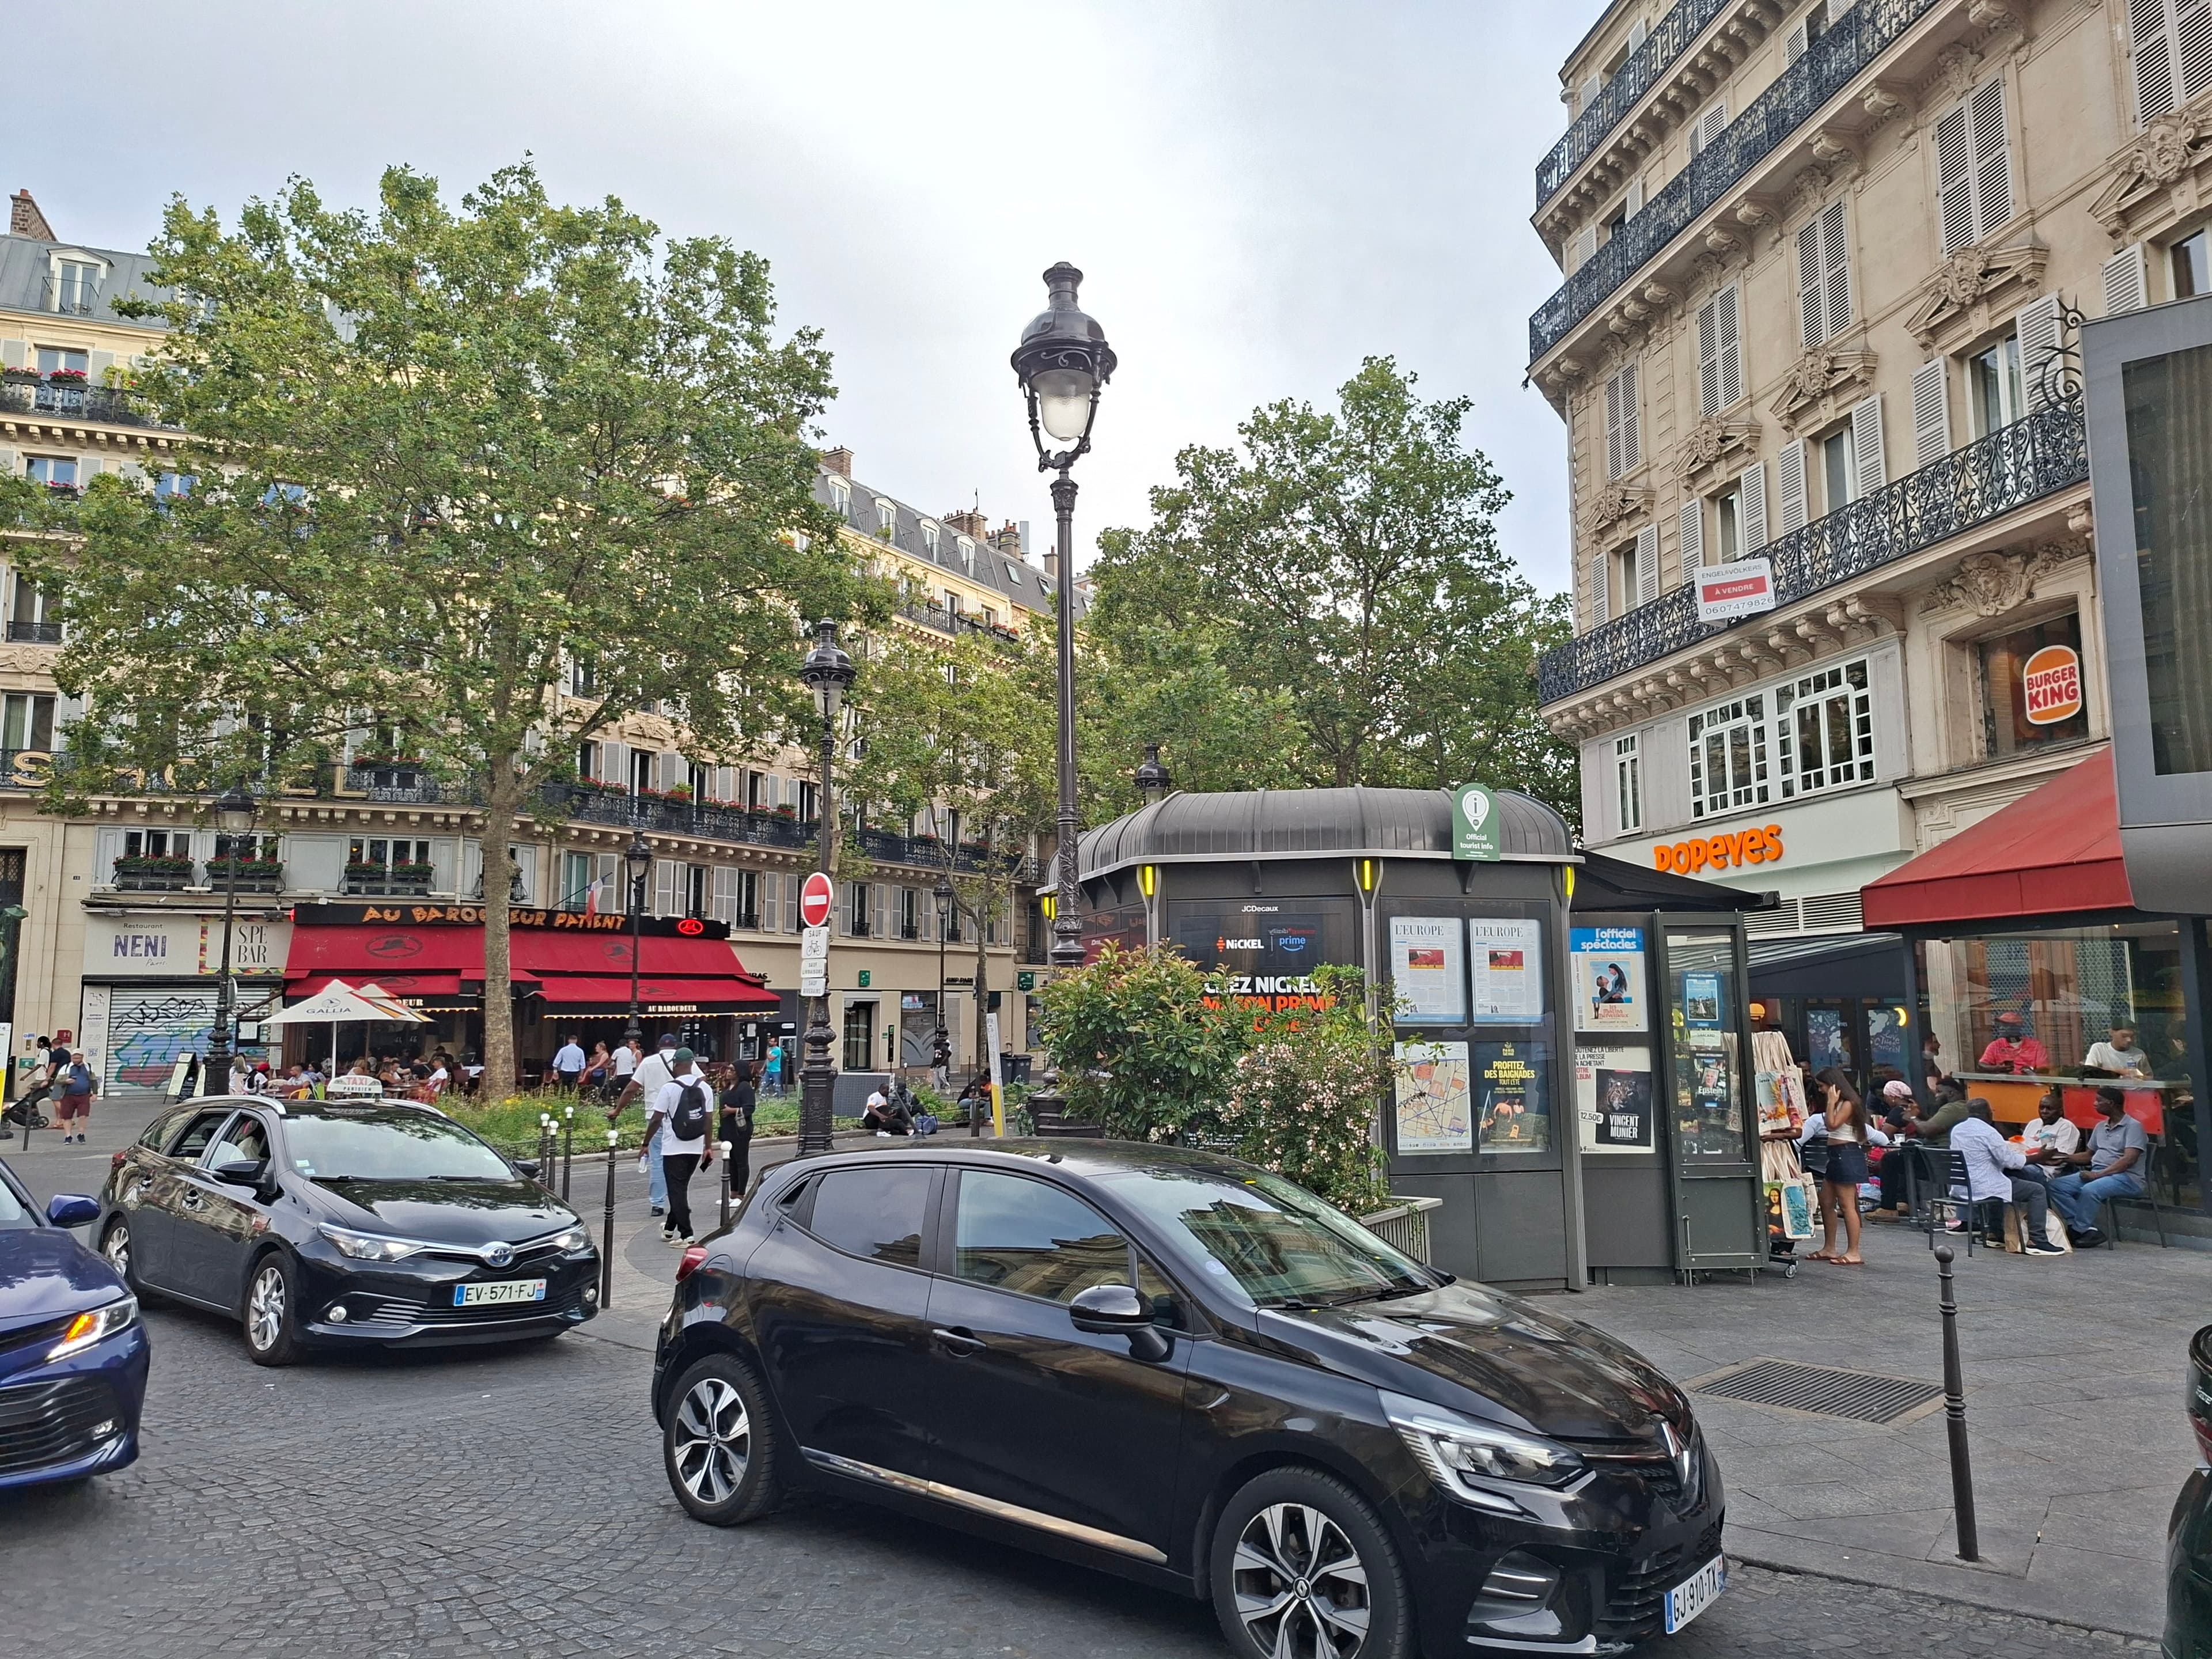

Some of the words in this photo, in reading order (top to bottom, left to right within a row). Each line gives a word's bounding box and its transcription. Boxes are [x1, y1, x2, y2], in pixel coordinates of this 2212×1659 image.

[1722, 584, 1754, 594] VENDRE
[1705, 596, 1774, 615] 0607479826
[2027, 666, 2077, 691] BURGER
[2028, 680, 2078, 711] KING
[362, 906, 402, 922] AU
[808, 929, 822, 938] SAUF
[1395, 925, 1444, 936] L'EUROPE
[1475, 926, 1524, 937] L'EUROPE
[1595, 928, 1636, 939] l'officiel
[113, 934, 167, 957] NENI
[1279, 935, 1306, 946] prime
[238, 945, 268, 963] BAR
[1493, 1060, 1525, 1070] PROFITEZ
[1484, 1070, 1498, 1079] DES
[1498, 1070, 1535, 1079] BAIGNADES
[346, 1077, 368, 1085] TAXI
[1698, 1086, 1724, 1094] Epstein
[1609, 1114, 1640, 1127] VINCENT
[1610, 1126, 1638, 1139] MUNIER
[465, 1283, 536, 1302] EV-571-FJ
[1673, 1563, 1717, 1623] GJ-910-TX
